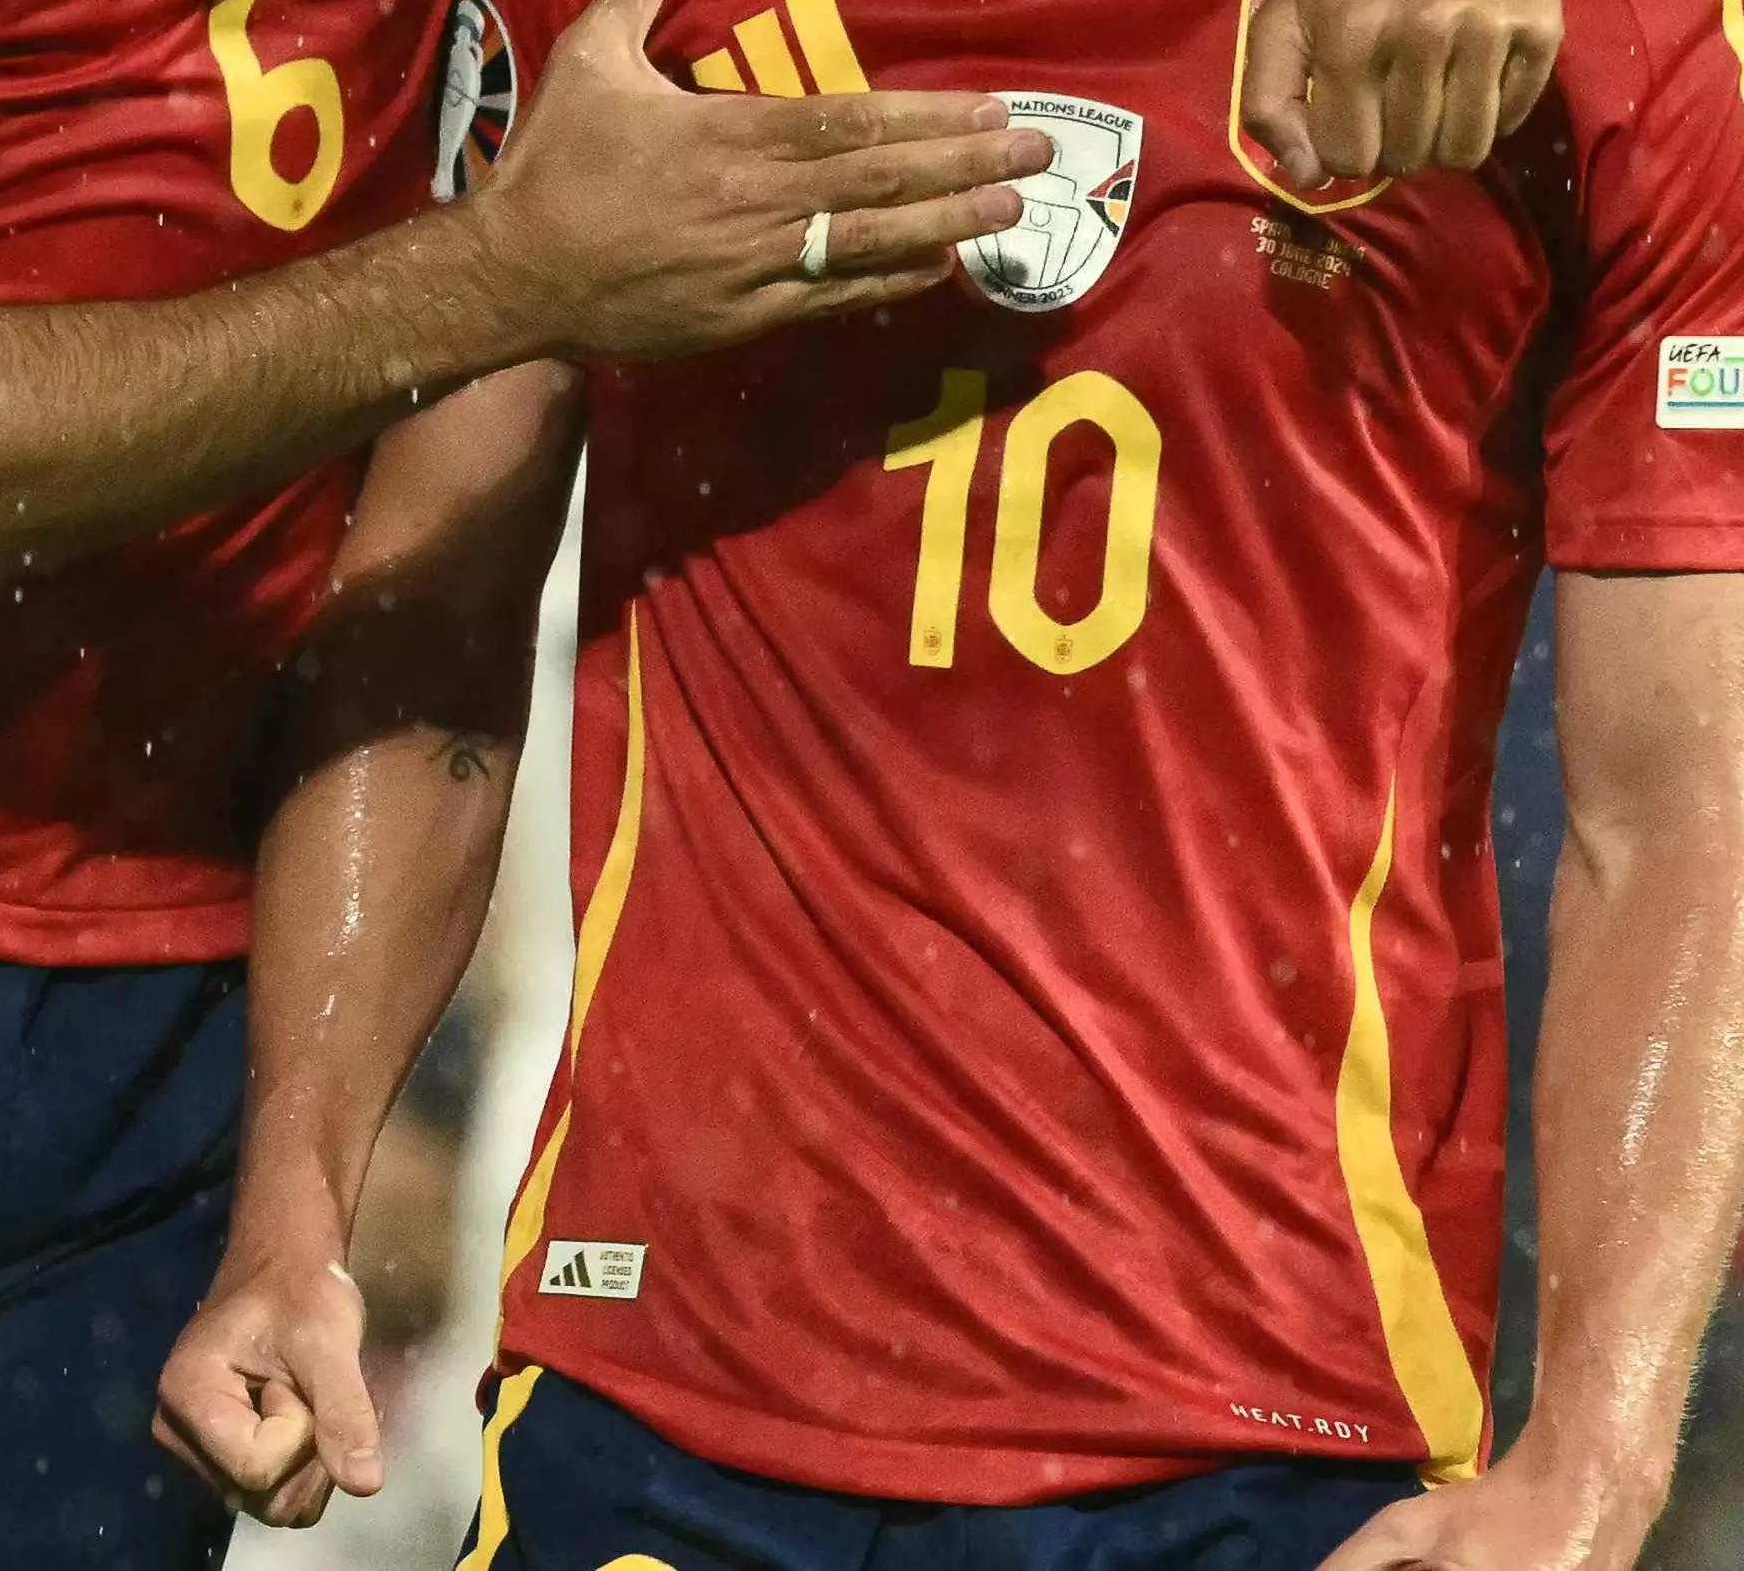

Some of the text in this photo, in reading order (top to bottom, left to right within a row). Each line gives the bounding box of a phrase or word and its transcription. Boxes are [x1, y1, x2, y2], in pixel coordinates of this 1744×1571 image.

[1011, 100, 1134, 132] NATIONS LEAGUE
[1668, 343, 1721, 363] UEFA
[883, 369, 1162, 675] 10
[1229, 1402, 1369, 1443] HEAT.RDY
